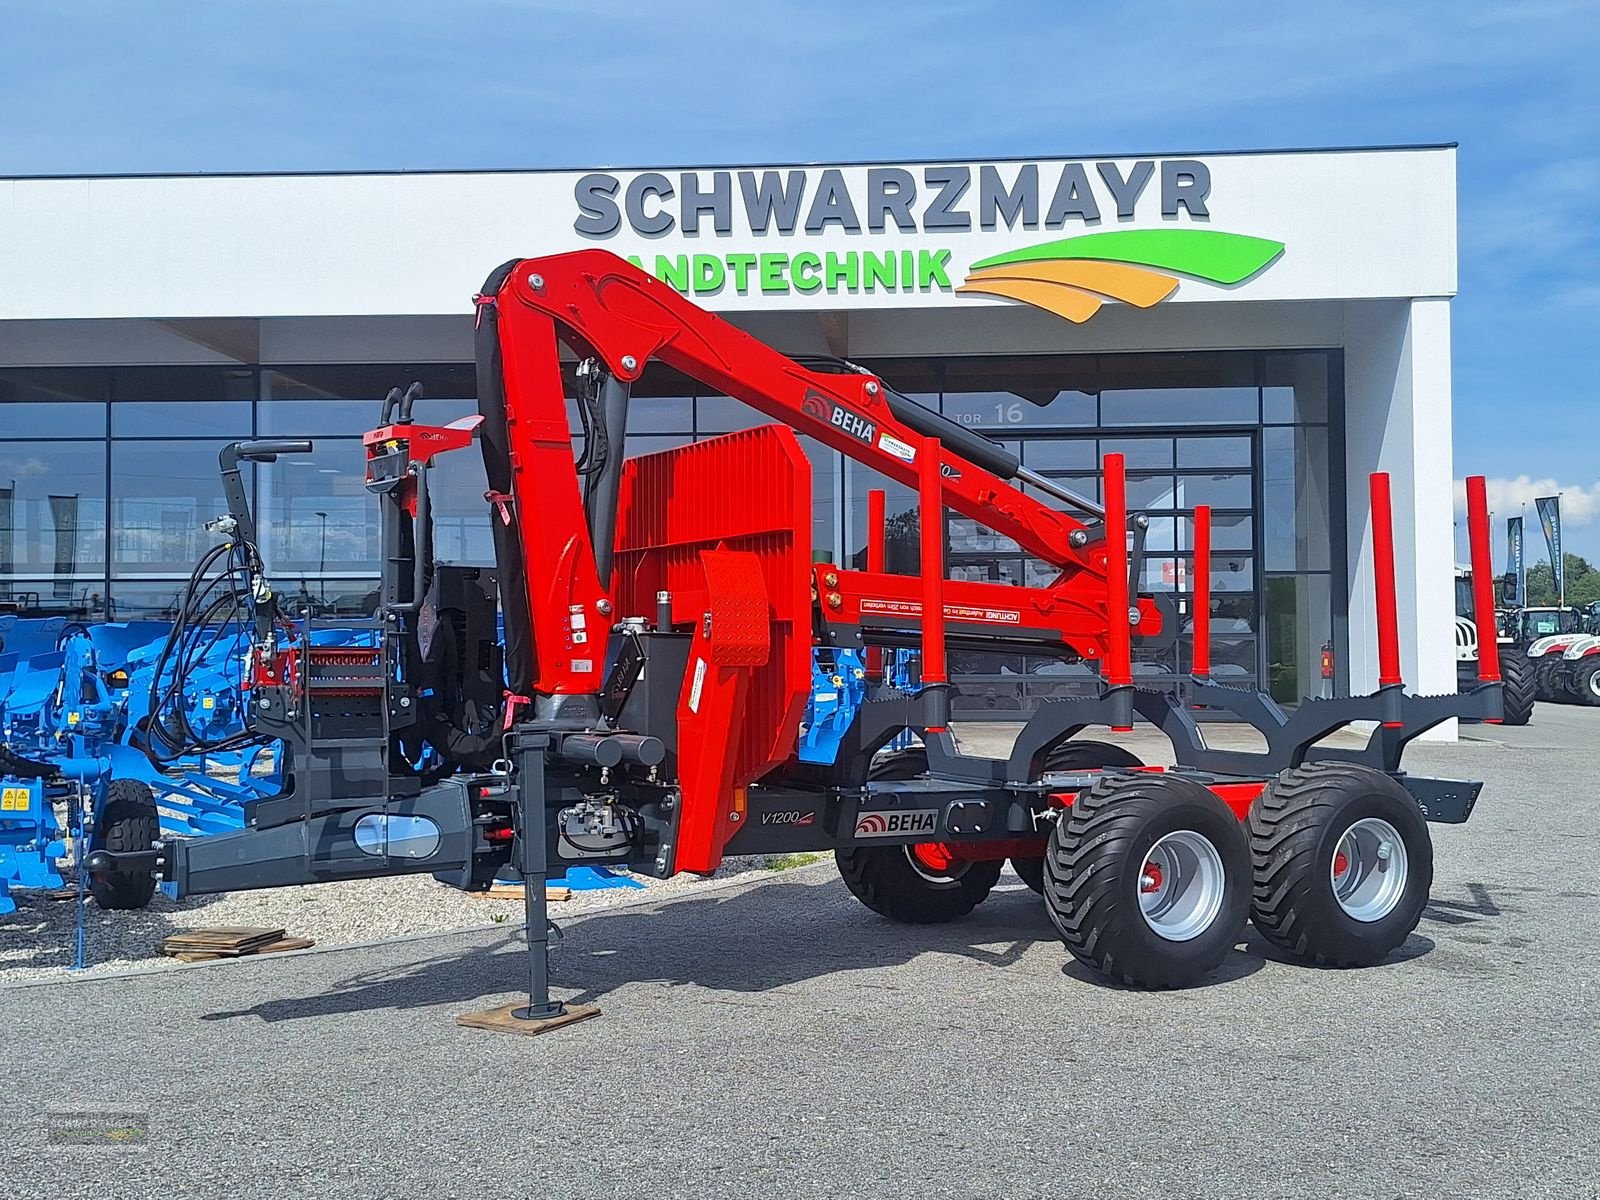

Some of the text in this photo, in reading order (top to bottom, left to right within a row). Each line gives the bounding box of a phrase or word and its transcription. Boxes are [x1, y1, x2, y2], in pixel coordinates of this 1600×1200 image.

[573, 159, 1212, 237] SCHWARZMAYR
[627, 249, 954, 295] NDTECHNIK
[830, 405, 874, 443] BEHA
[955, 402, 1024, 424] TOR 16
[762, 811, 799, 825] V1200
[887, 813, 935, 832] BEHA
